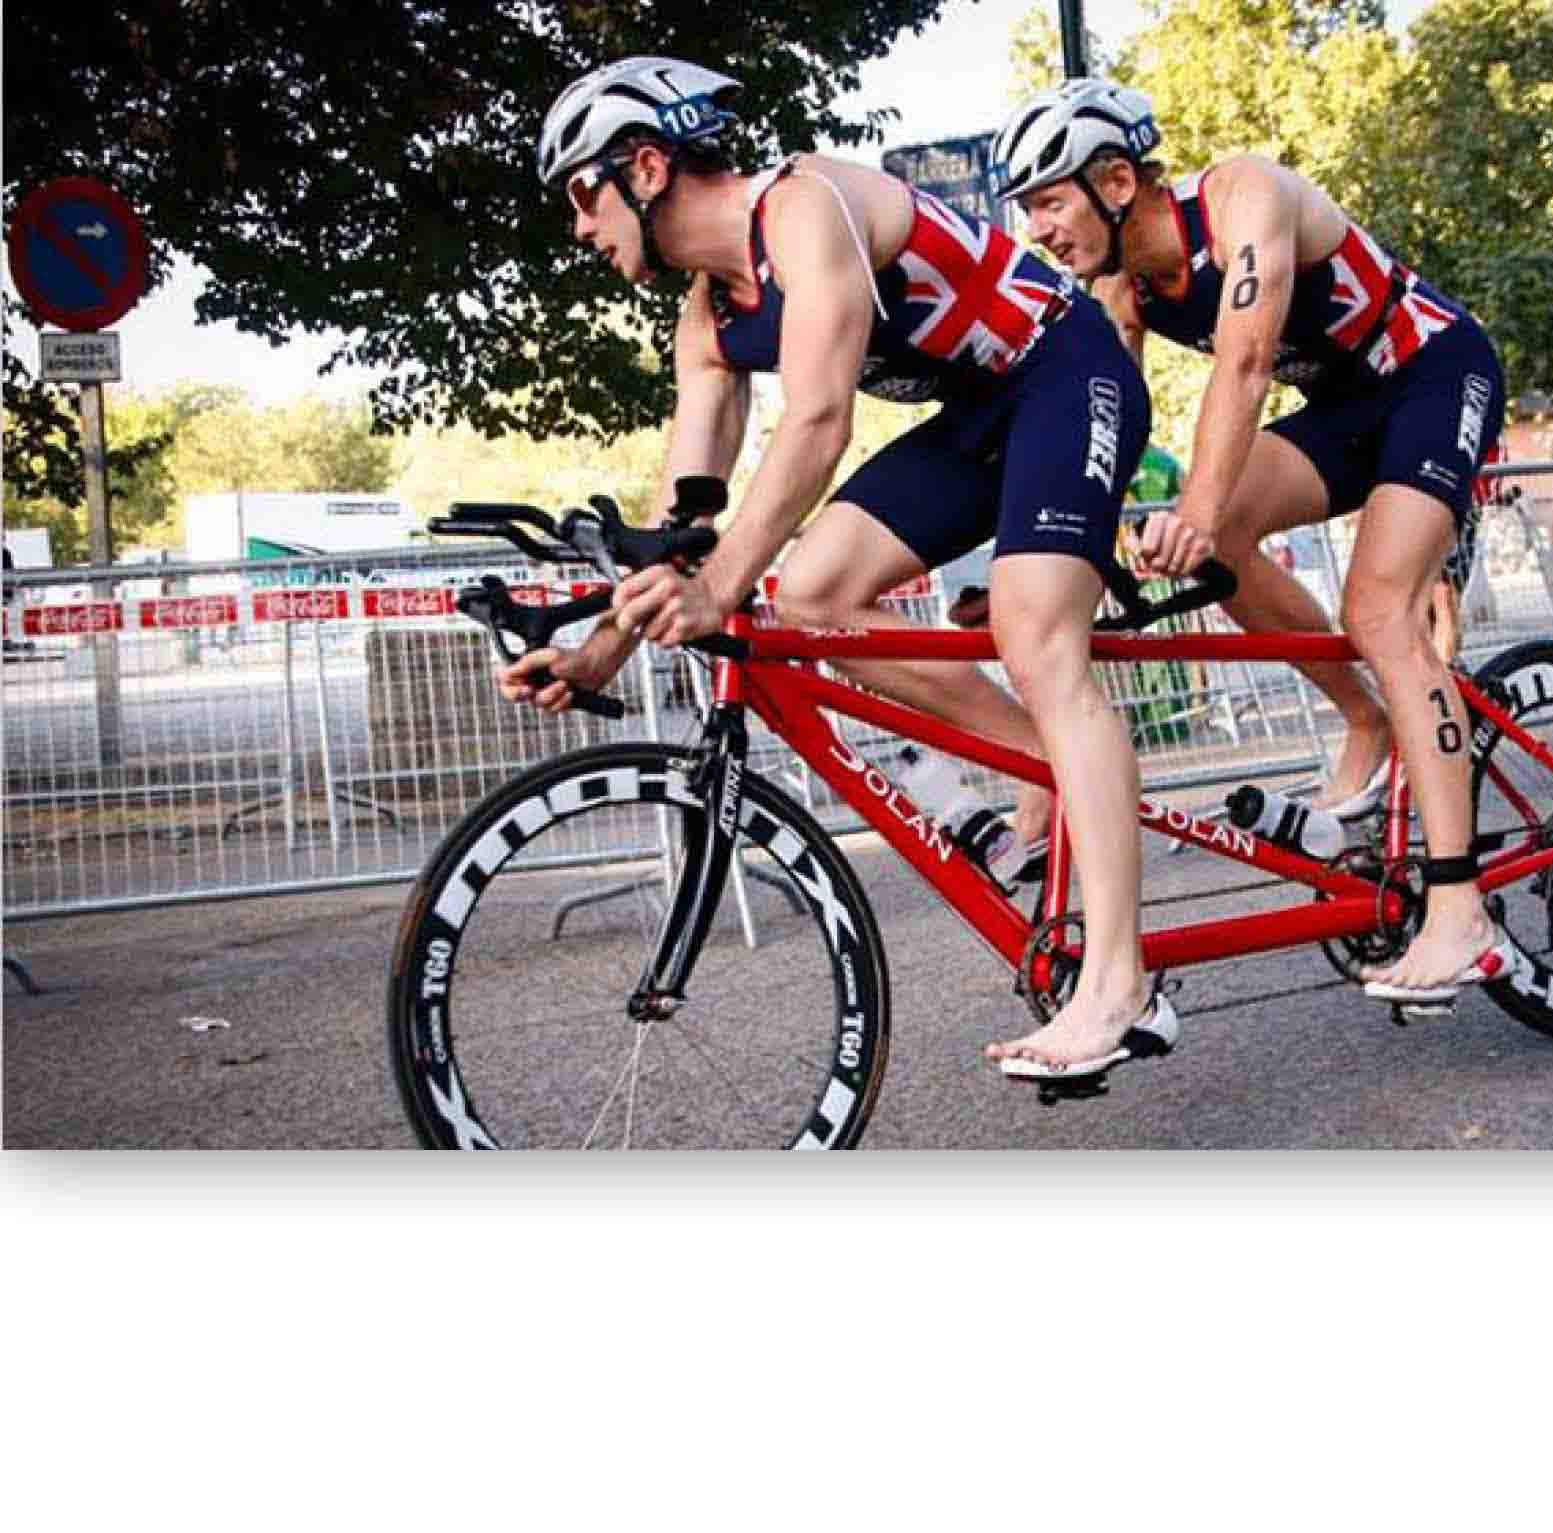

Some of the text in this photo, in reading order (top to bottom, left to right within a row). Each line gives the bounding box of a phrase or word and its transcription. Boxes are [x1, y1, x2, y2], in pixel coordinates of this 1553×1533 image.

[662, 103, 699, 136] 10
[1128, 124, 1153, 152] 10
[828, 740, 953, 861] DOLAN
